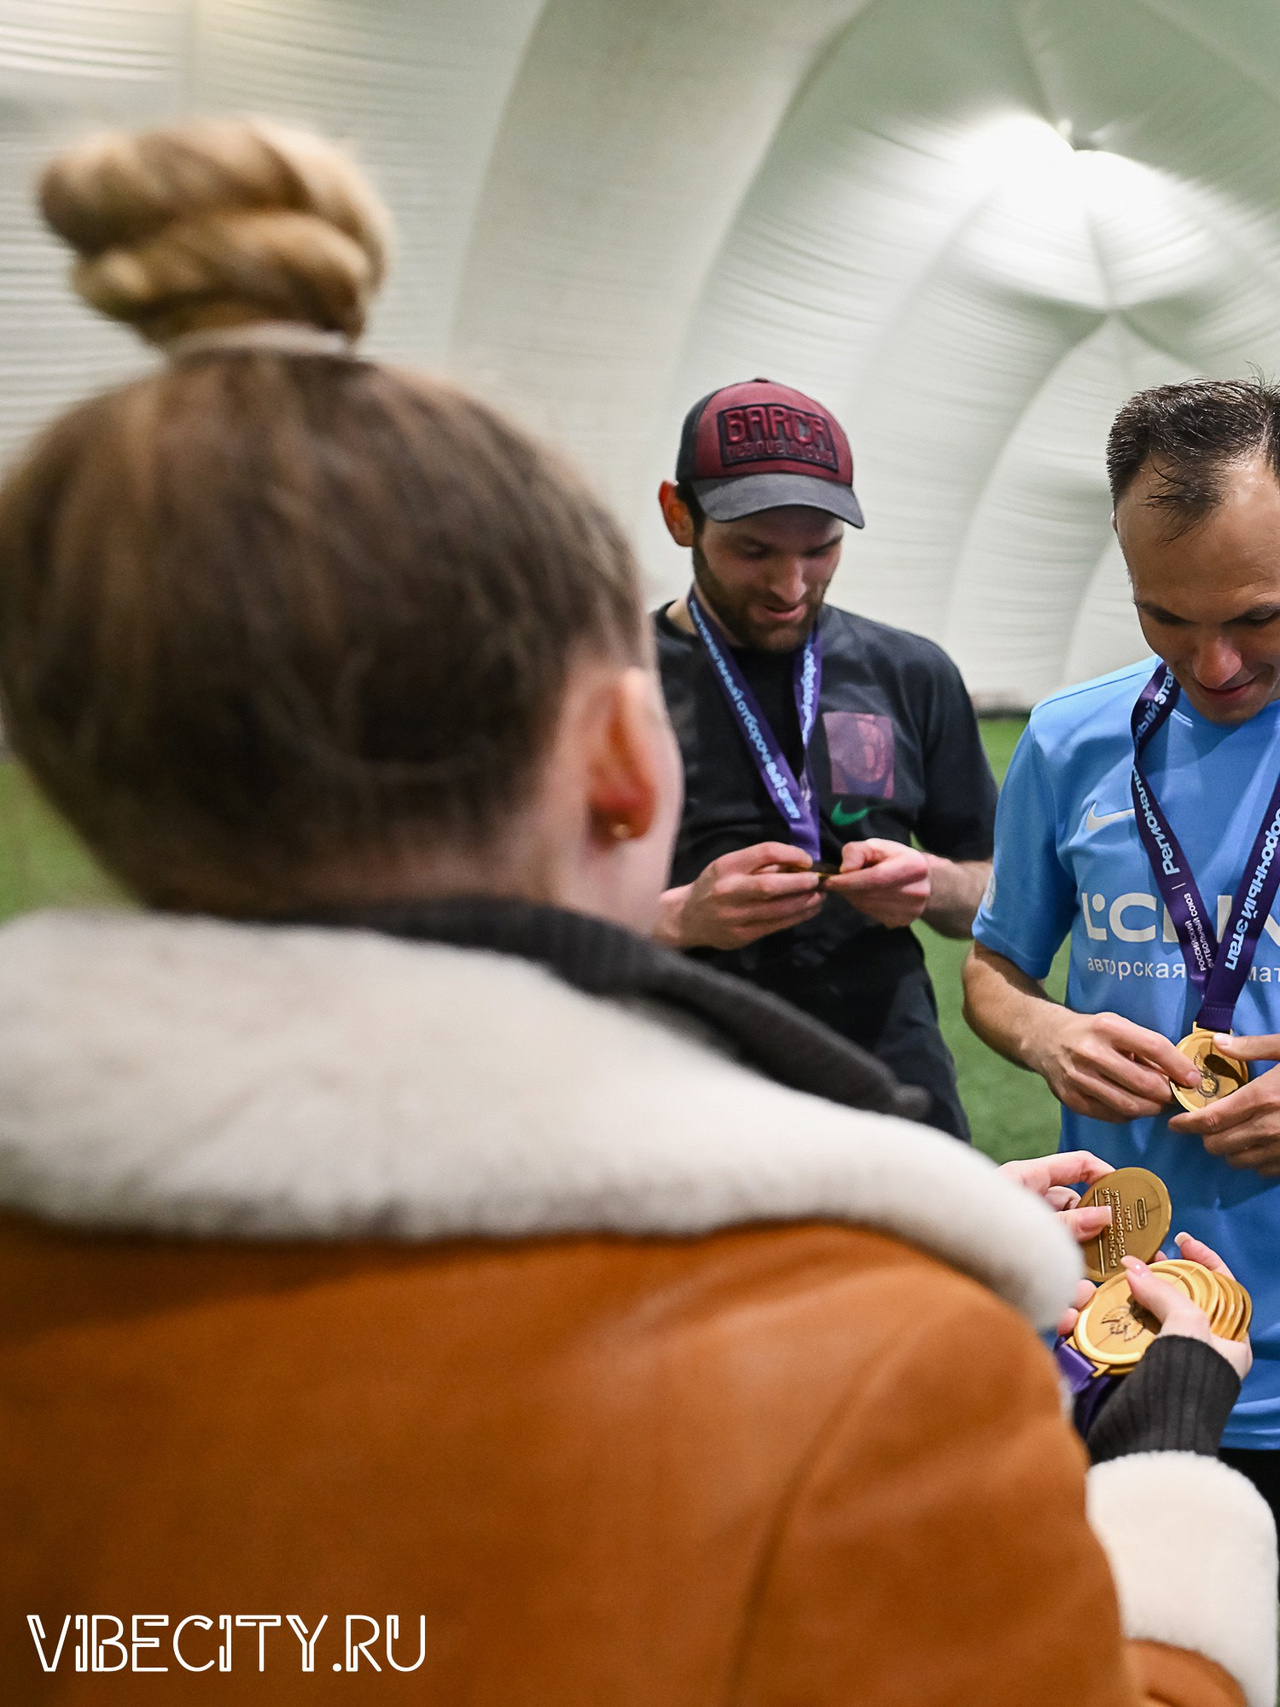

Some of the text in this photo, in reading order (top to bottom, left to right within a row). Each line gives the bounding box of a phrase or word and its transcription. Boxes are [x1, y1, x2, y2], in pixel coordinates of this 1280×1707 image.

[1183, 892, 1199, 917] СОЮЗ
[1224, 917, 1249, 970] этап
[1087, 957, 1186, 980] авторская
